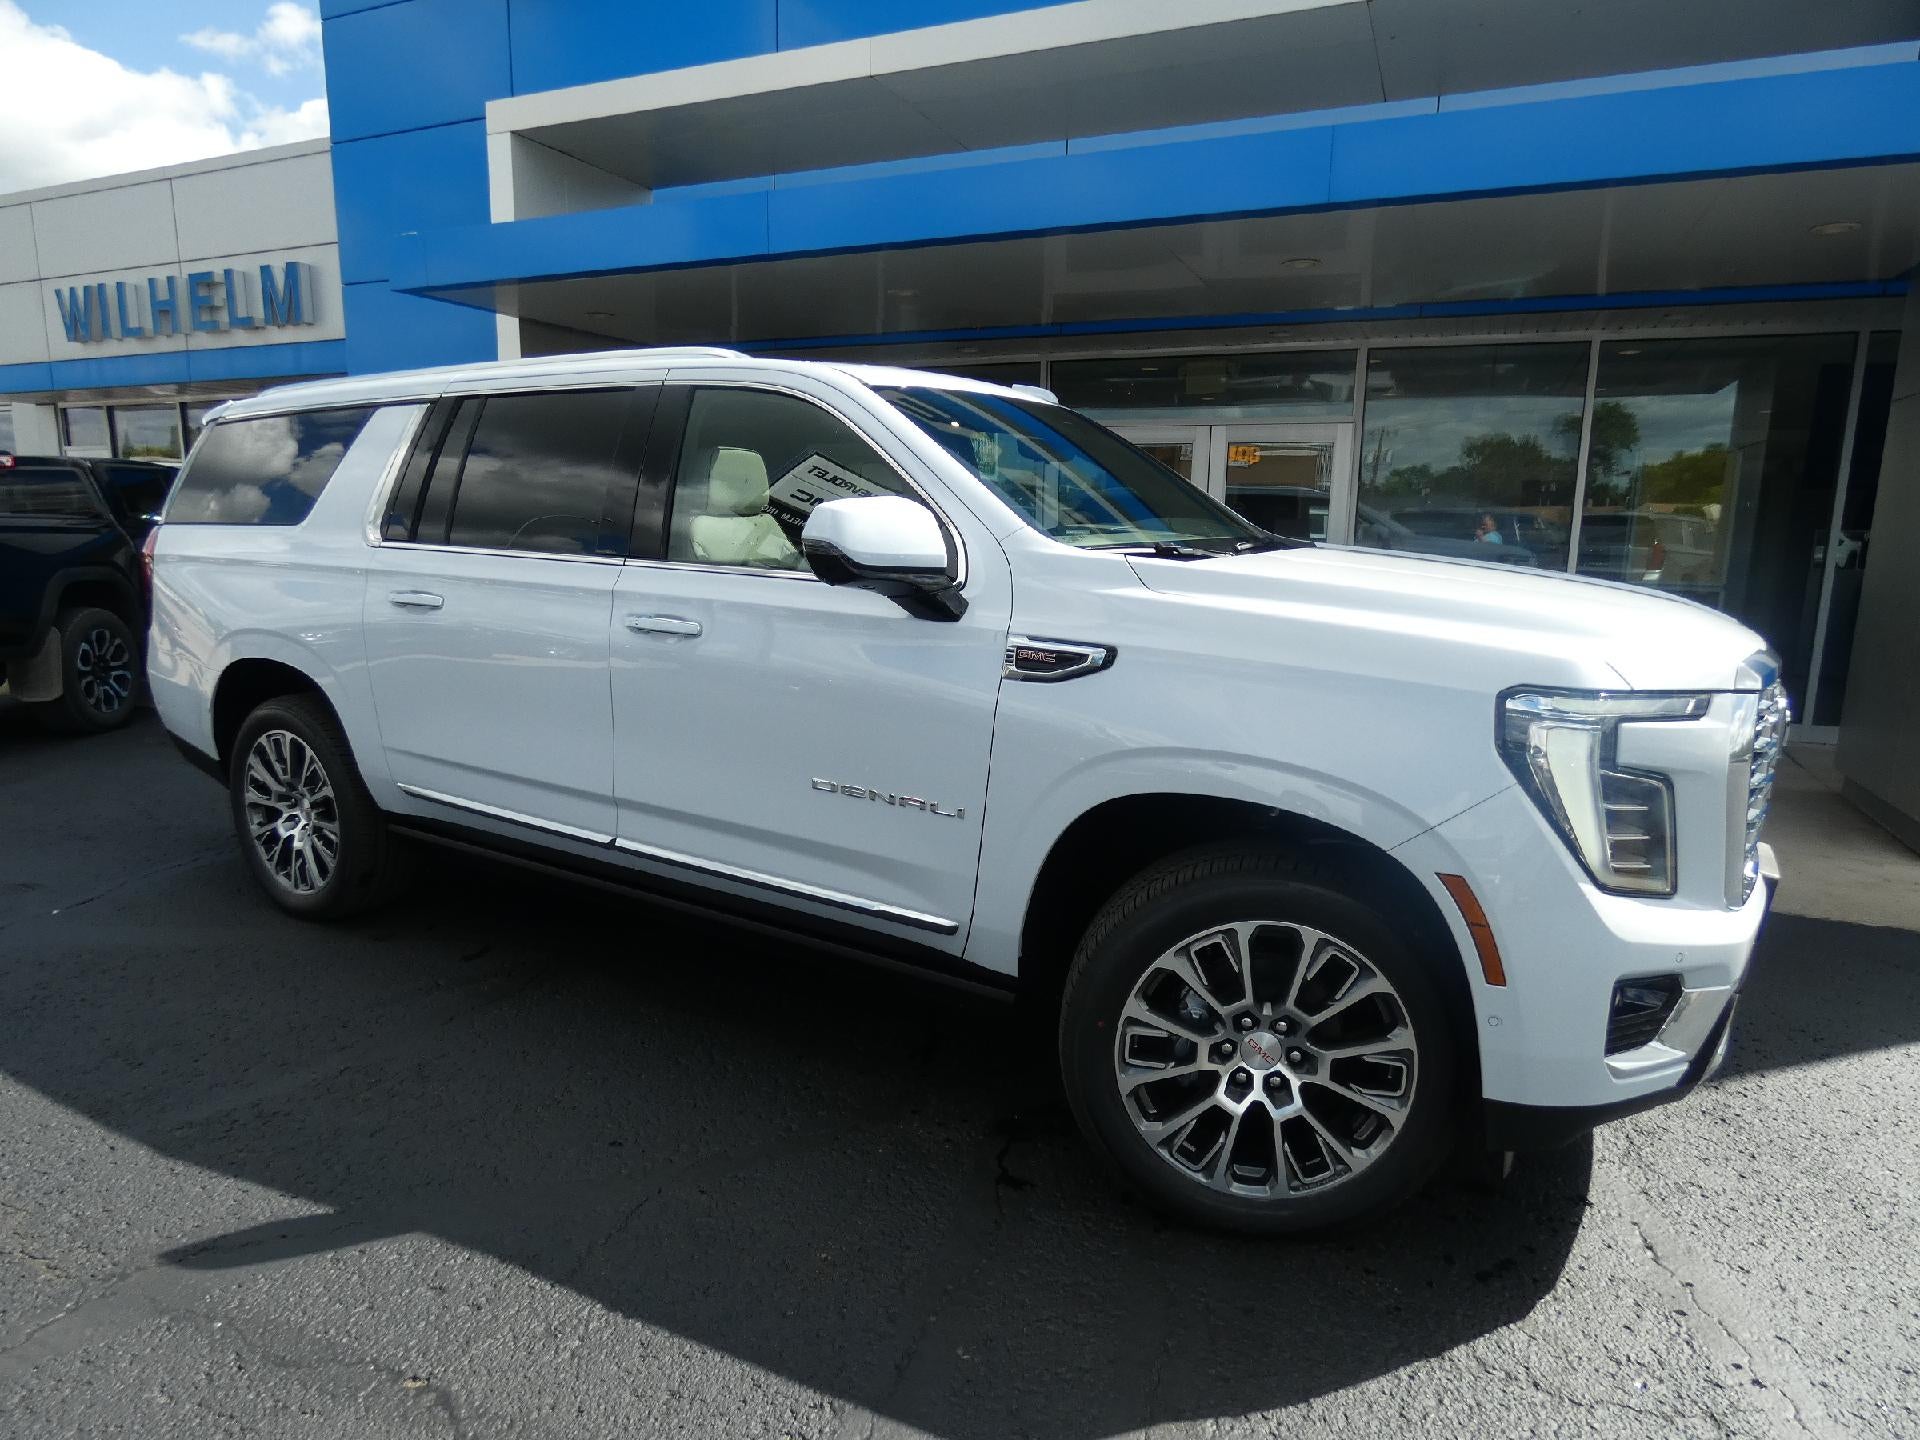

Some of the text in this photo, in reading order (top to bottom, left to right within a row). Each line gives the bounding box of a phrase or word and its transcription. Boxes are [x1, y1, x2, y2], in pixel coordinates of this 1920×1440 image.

[55, 262, 313, 343] WILHELM
[1017, 649, 1056, 663] GMC
[812, 778, 965, 819] DENALI
[1247, 1038, 1276, 1065] GMC
